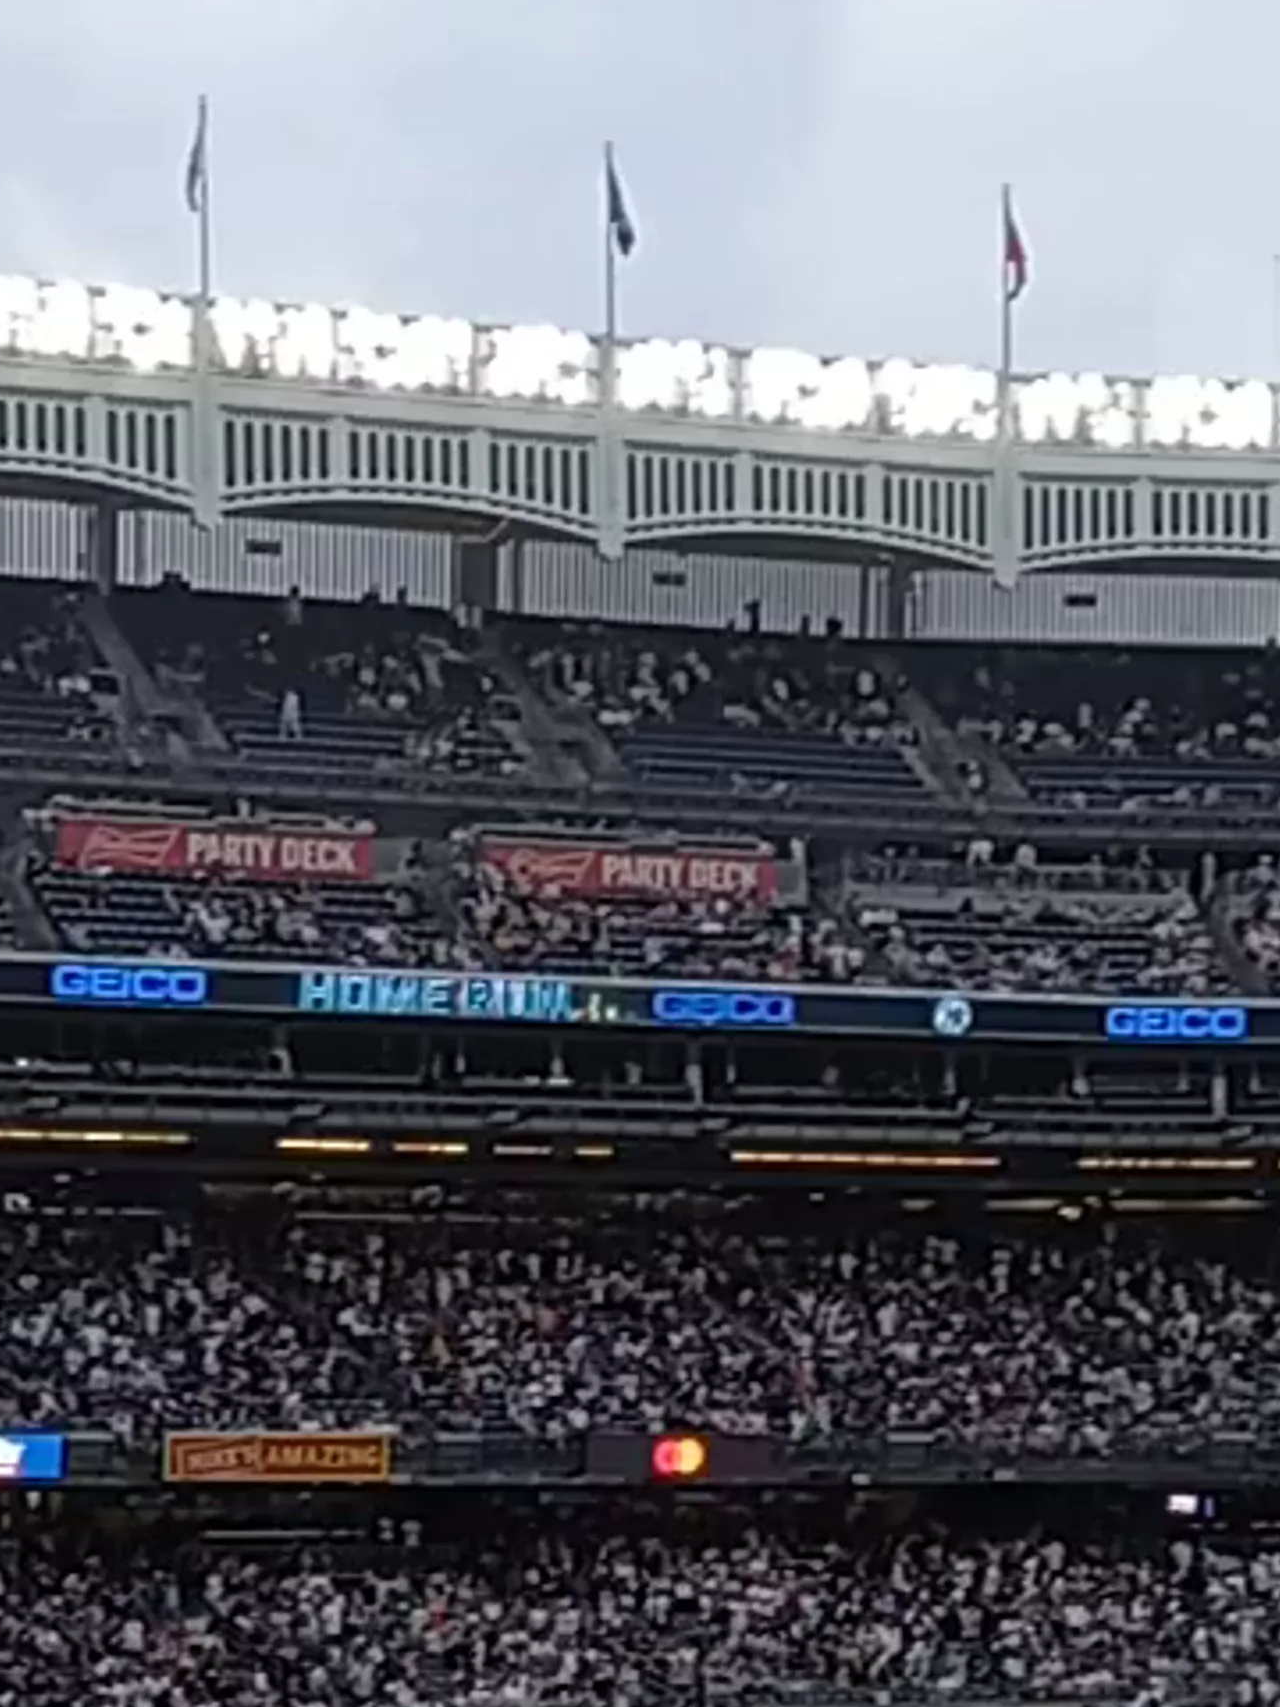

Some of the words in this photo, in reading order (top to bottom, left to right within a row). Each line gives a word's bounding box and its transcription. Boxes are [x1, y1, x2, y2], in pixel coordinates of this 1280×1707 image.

[187, 834, 277, 868] PARTY
[282, 837, 358, 872] DECK
[602, 853, 684, 888] PARTY
[689, 859, 758, 892] DECK
[52, 964, 206, 1002] GEICO
[298, 972, 457, 1015] HOME
[1106, 1005, 1247, 1037] GEICO
